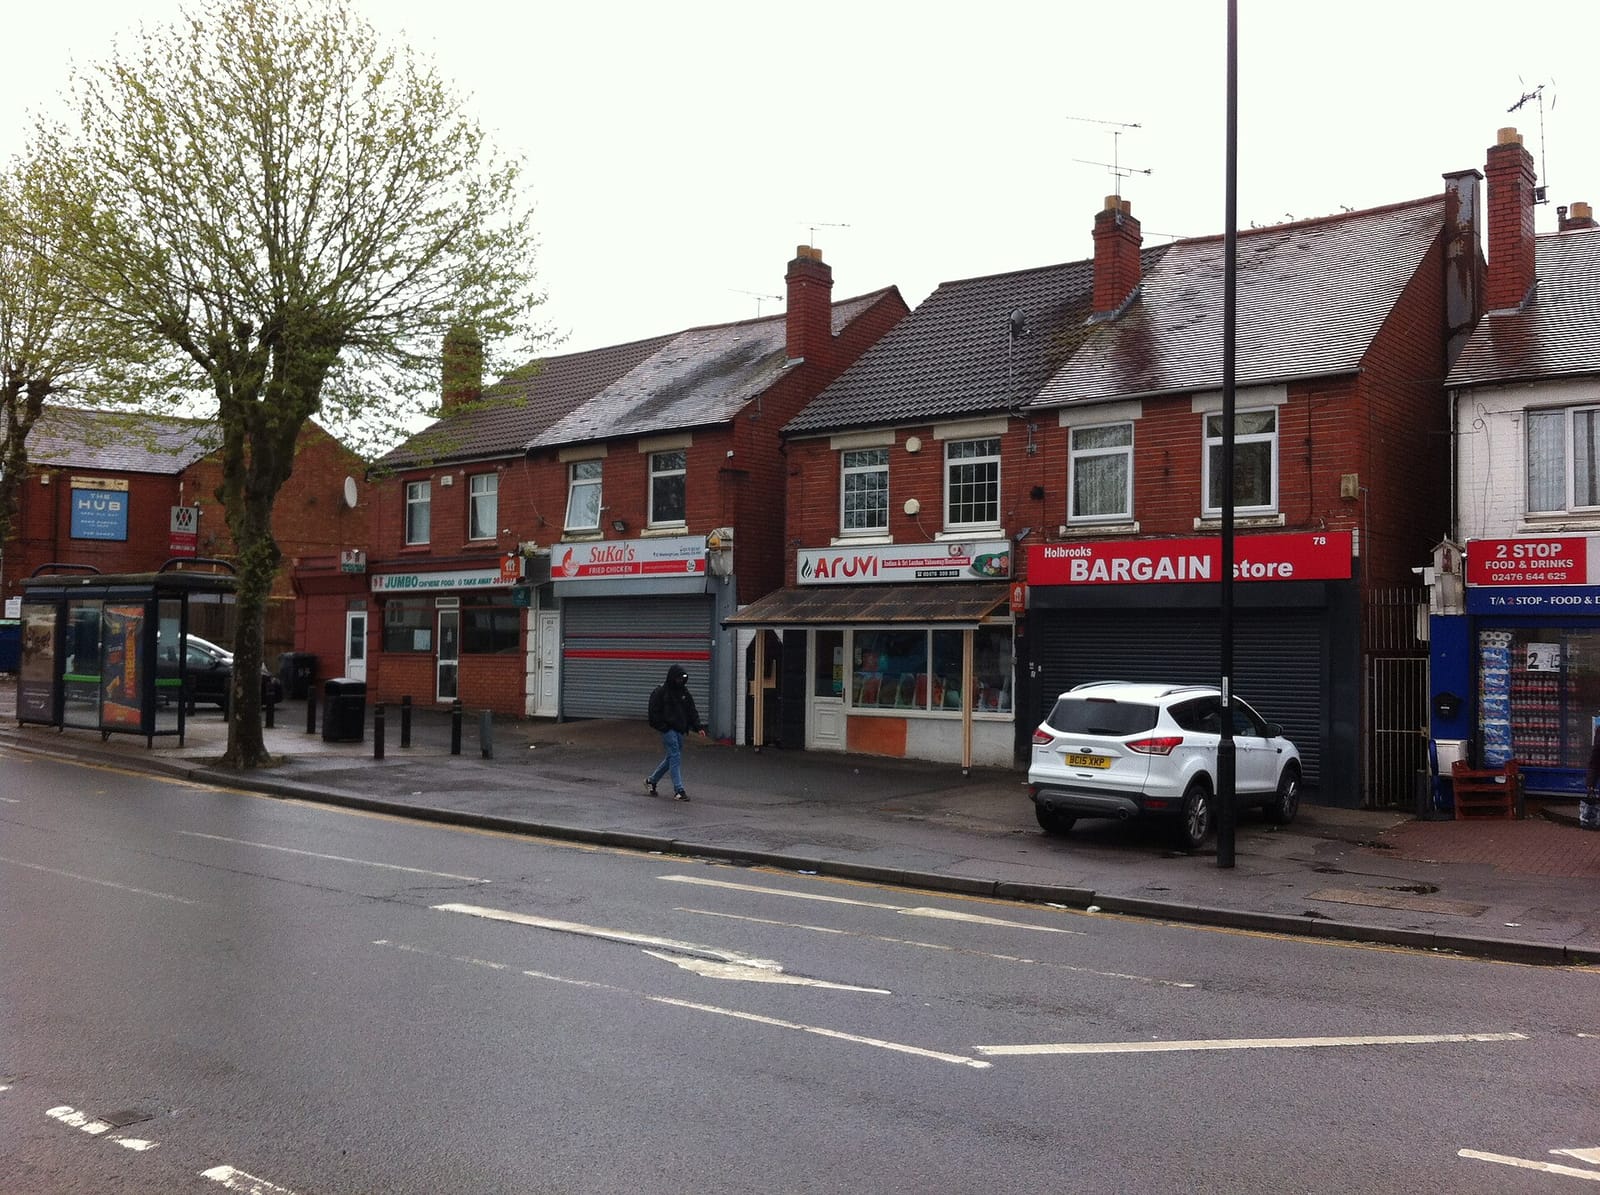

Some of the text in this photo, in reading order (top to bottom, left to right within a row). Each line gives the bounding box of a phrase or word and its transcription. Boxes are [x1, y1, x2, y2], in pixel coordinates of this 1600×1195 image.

[79, 500, 120, 510] HUB
[1313, 536, 1327, 545] 78
[589, 545, 634, 563] SuKa's
[1044, 546, 1092, 558] Holbrooks
[1496, 543, 1562, 558] 2 STOP
[1070, 555, 1211, 581] BARGAIN
[1485, 559, 1574, 569] FOOD & DRINKS
[385, 576, 418, 588] JUMBO
[1491, 573, 1523, 581] 02476
[1547, 572, 1567, 580] 625
[1490, 596, 1506, 605] T/A
[1507, 597, 1514, 605] 2
[1516, 596, 1543, 604] STOP
[1550, 596, 1582, 604] FOOD
[1584, 596, 1593, 604] &
[1528, 652, 1540, 669] 2
[1069, 755, 1105, 766] BC15 XKP
